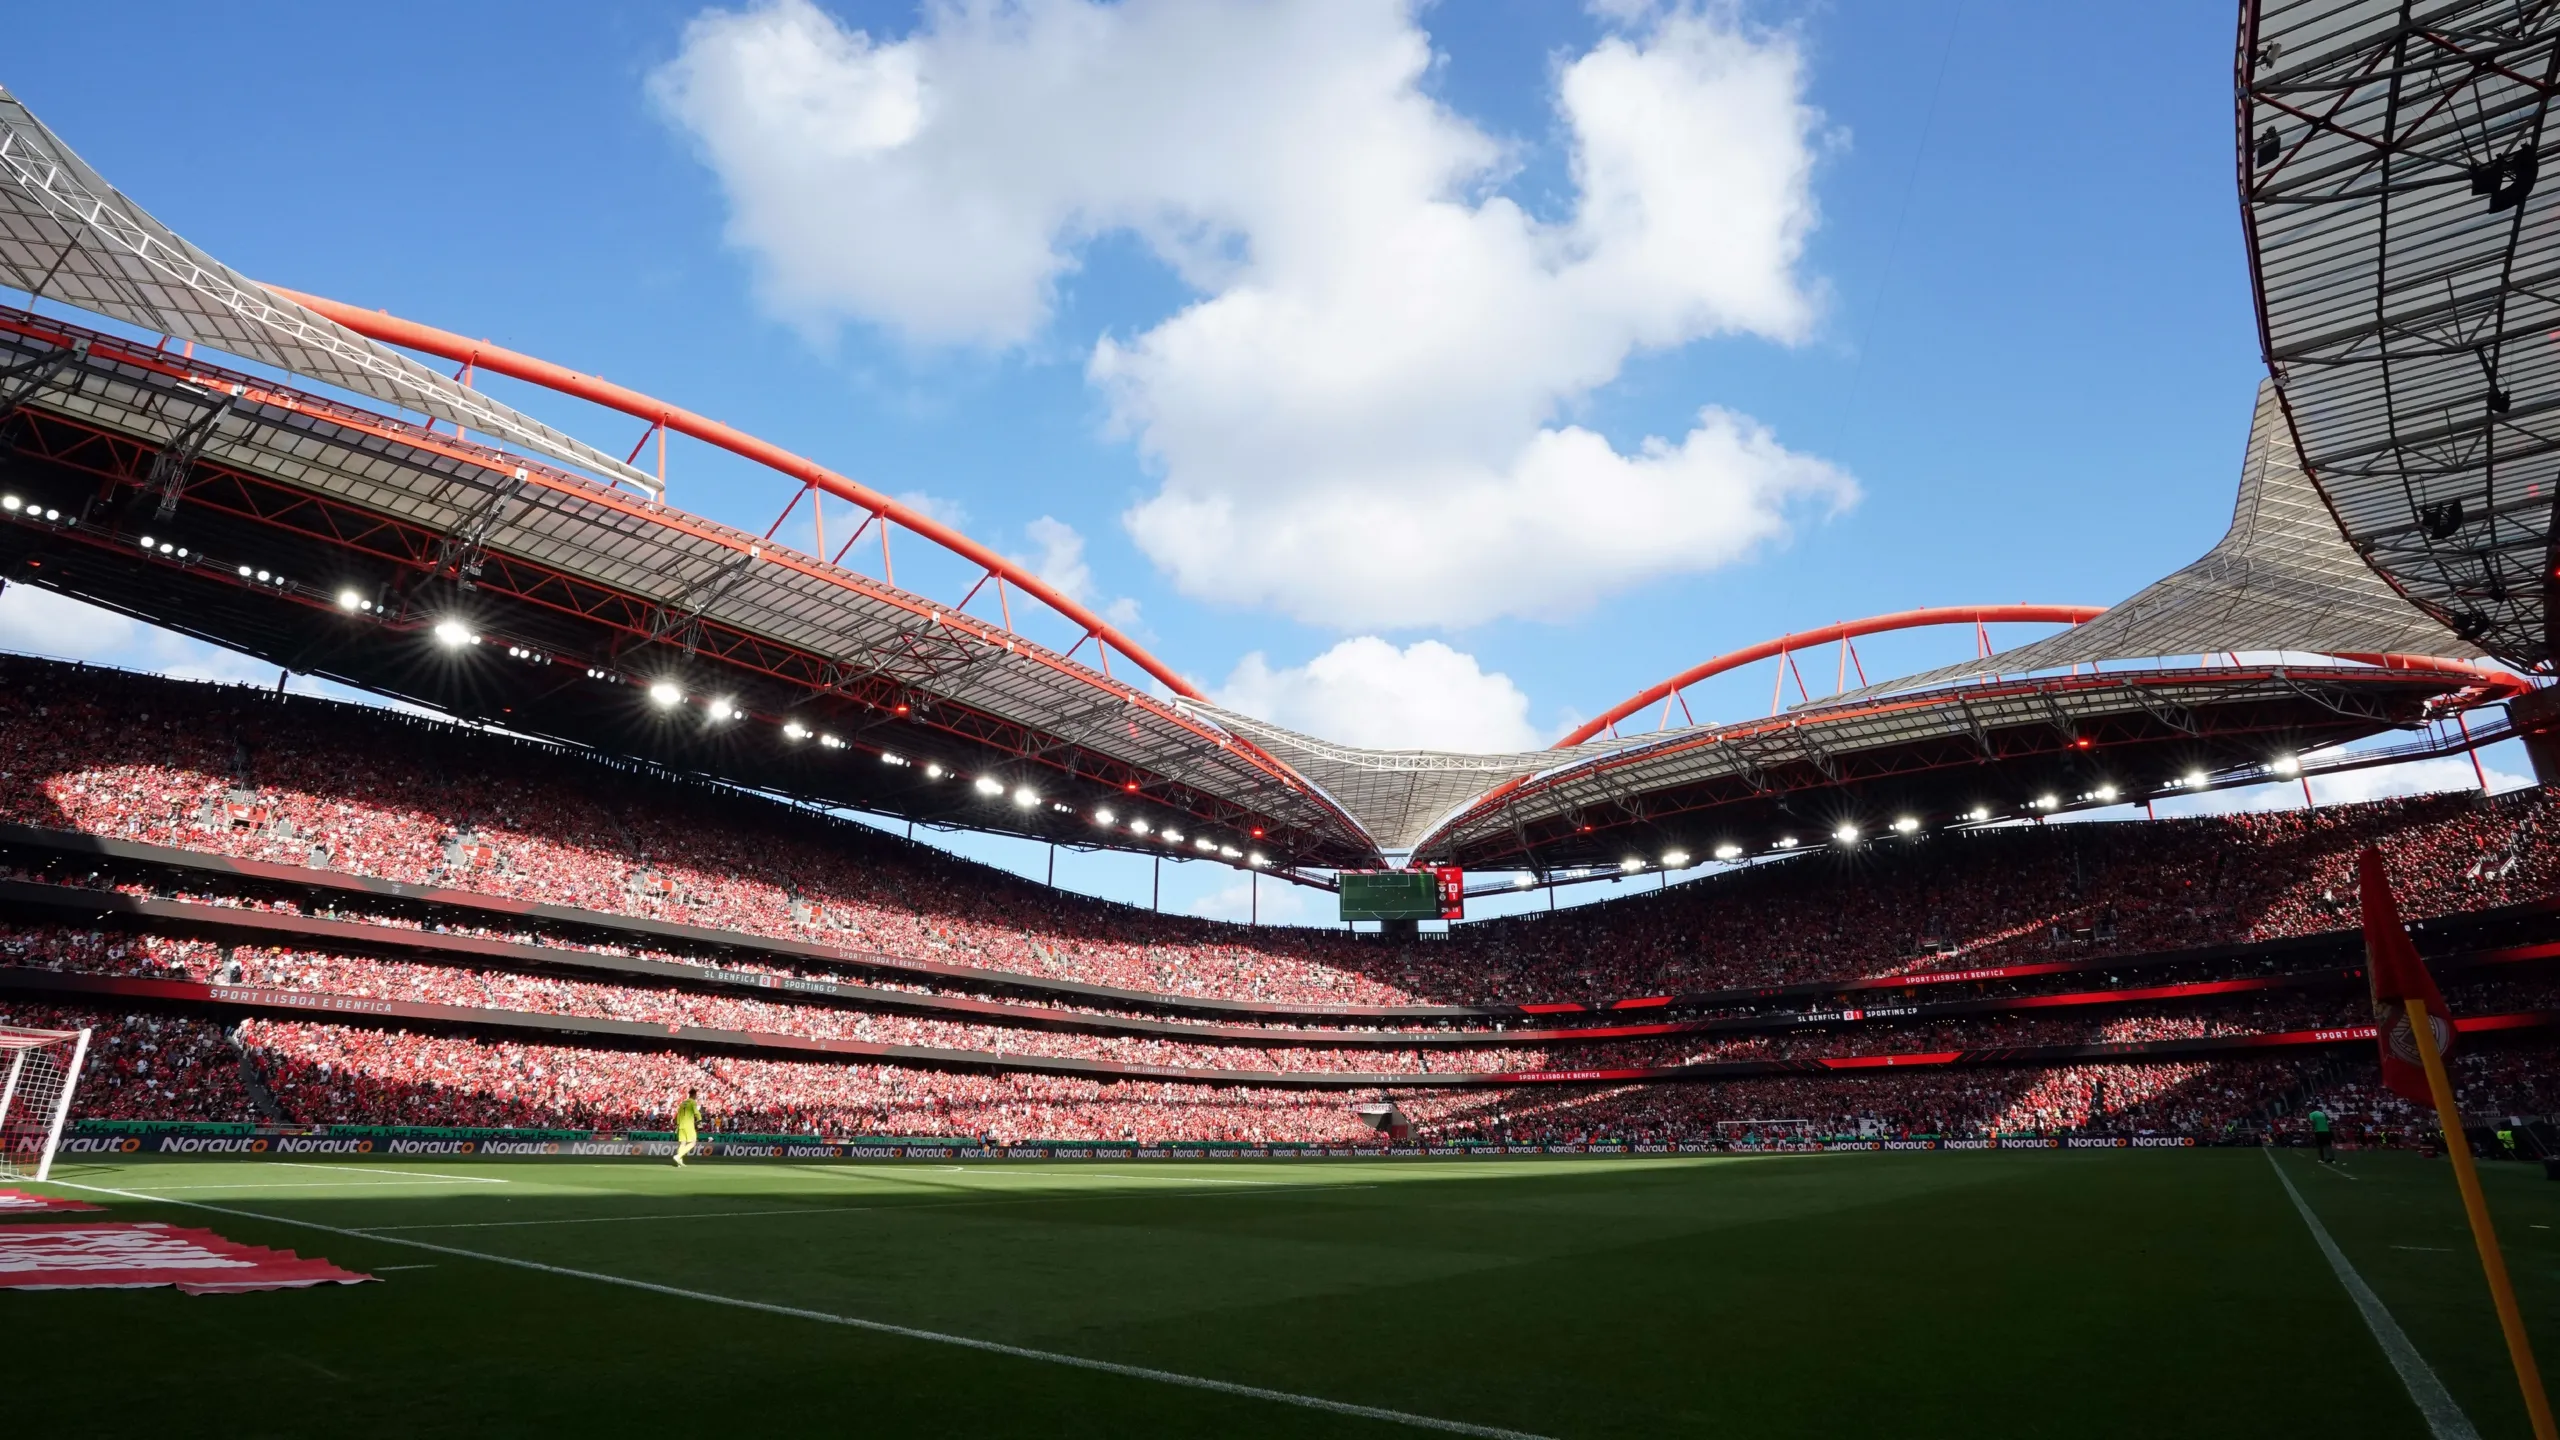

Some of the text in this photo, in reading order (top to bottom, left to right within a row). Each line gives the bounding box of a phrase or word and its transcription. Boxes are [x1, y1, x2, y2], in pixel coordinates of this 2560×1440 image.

[840, 951, 862, 960] SPORT
[866, 955, 890, 964] LISBOA
[899, 960, 927, 969] BENFICA
[705, 970, 715, 979] SL
[719, 973, 755, 983] BENFICA
[785, 980, 824, 991] SPORTING
[827, 985, 837, 993] CP
[1906, 976, 1930, 984] SPORT
[1971, 970, 2004, 978] BENFICA
[210, 989, 392, 1012] SPORT LISBOA E BENFICA
[1866, 1009, 1905, 1018] SPORTING
[2315, 1029, 2377, 1040] SPORT LISB
[160, 1136, 268, 1152] Norauto
[276, 1138, 373, 1153] Norauto
[388, 1139, 474, 1154] Norauto
[481, 1140, 560, 1154] Norauto
[572, 1142, 643, 1156] Norauto
[648, 1144, 714, 1156] Noruto
[723, 1144, 783, 1157] Norauto
[788, 1145, 842, 1157] Norauto
[852, 1146, 902, 1158] Norauto
[906, 1147, 953, 1158] Norauto
[1008, 1148, 1048, 1158] Norauto
[1055, 1148, 1093, 1158] Norauto
[1096, 1149, 1131, 1158] Norauto
[1137, 1149, 1170, 1158] Norauto
[1173, 1149, 1204, 1158] Norauto
[1209, 1149, 1238, 1158] Norauto
[1241, 1149, 1268, 1158] Norauto
[1273, 1149, 1299, 1157] Norauto
[1301, 1149, 1326, 1157] Norauto
[1329, 1149, 1352, 1157] Norauto
[1391, 1148, 1425, 1156] Norauto
[1429, 1148, 1465, 1156] Norauto
[1471, 1146, 1505, 1154] Norauto
[1508, 1146, 1542, 1154] Norauto
[1589, 1144, 1628, 1153] Norauto
[1884, 1141, 1935, 1150] Norauto
[1944, 1140, 1997, 1149] Norauto
[2002, 1139, 2058, 1148] Norauto
[2068, 1138, 2126, 1147] Norauto
[2132, 1137, 2195, 1147] Norauto
